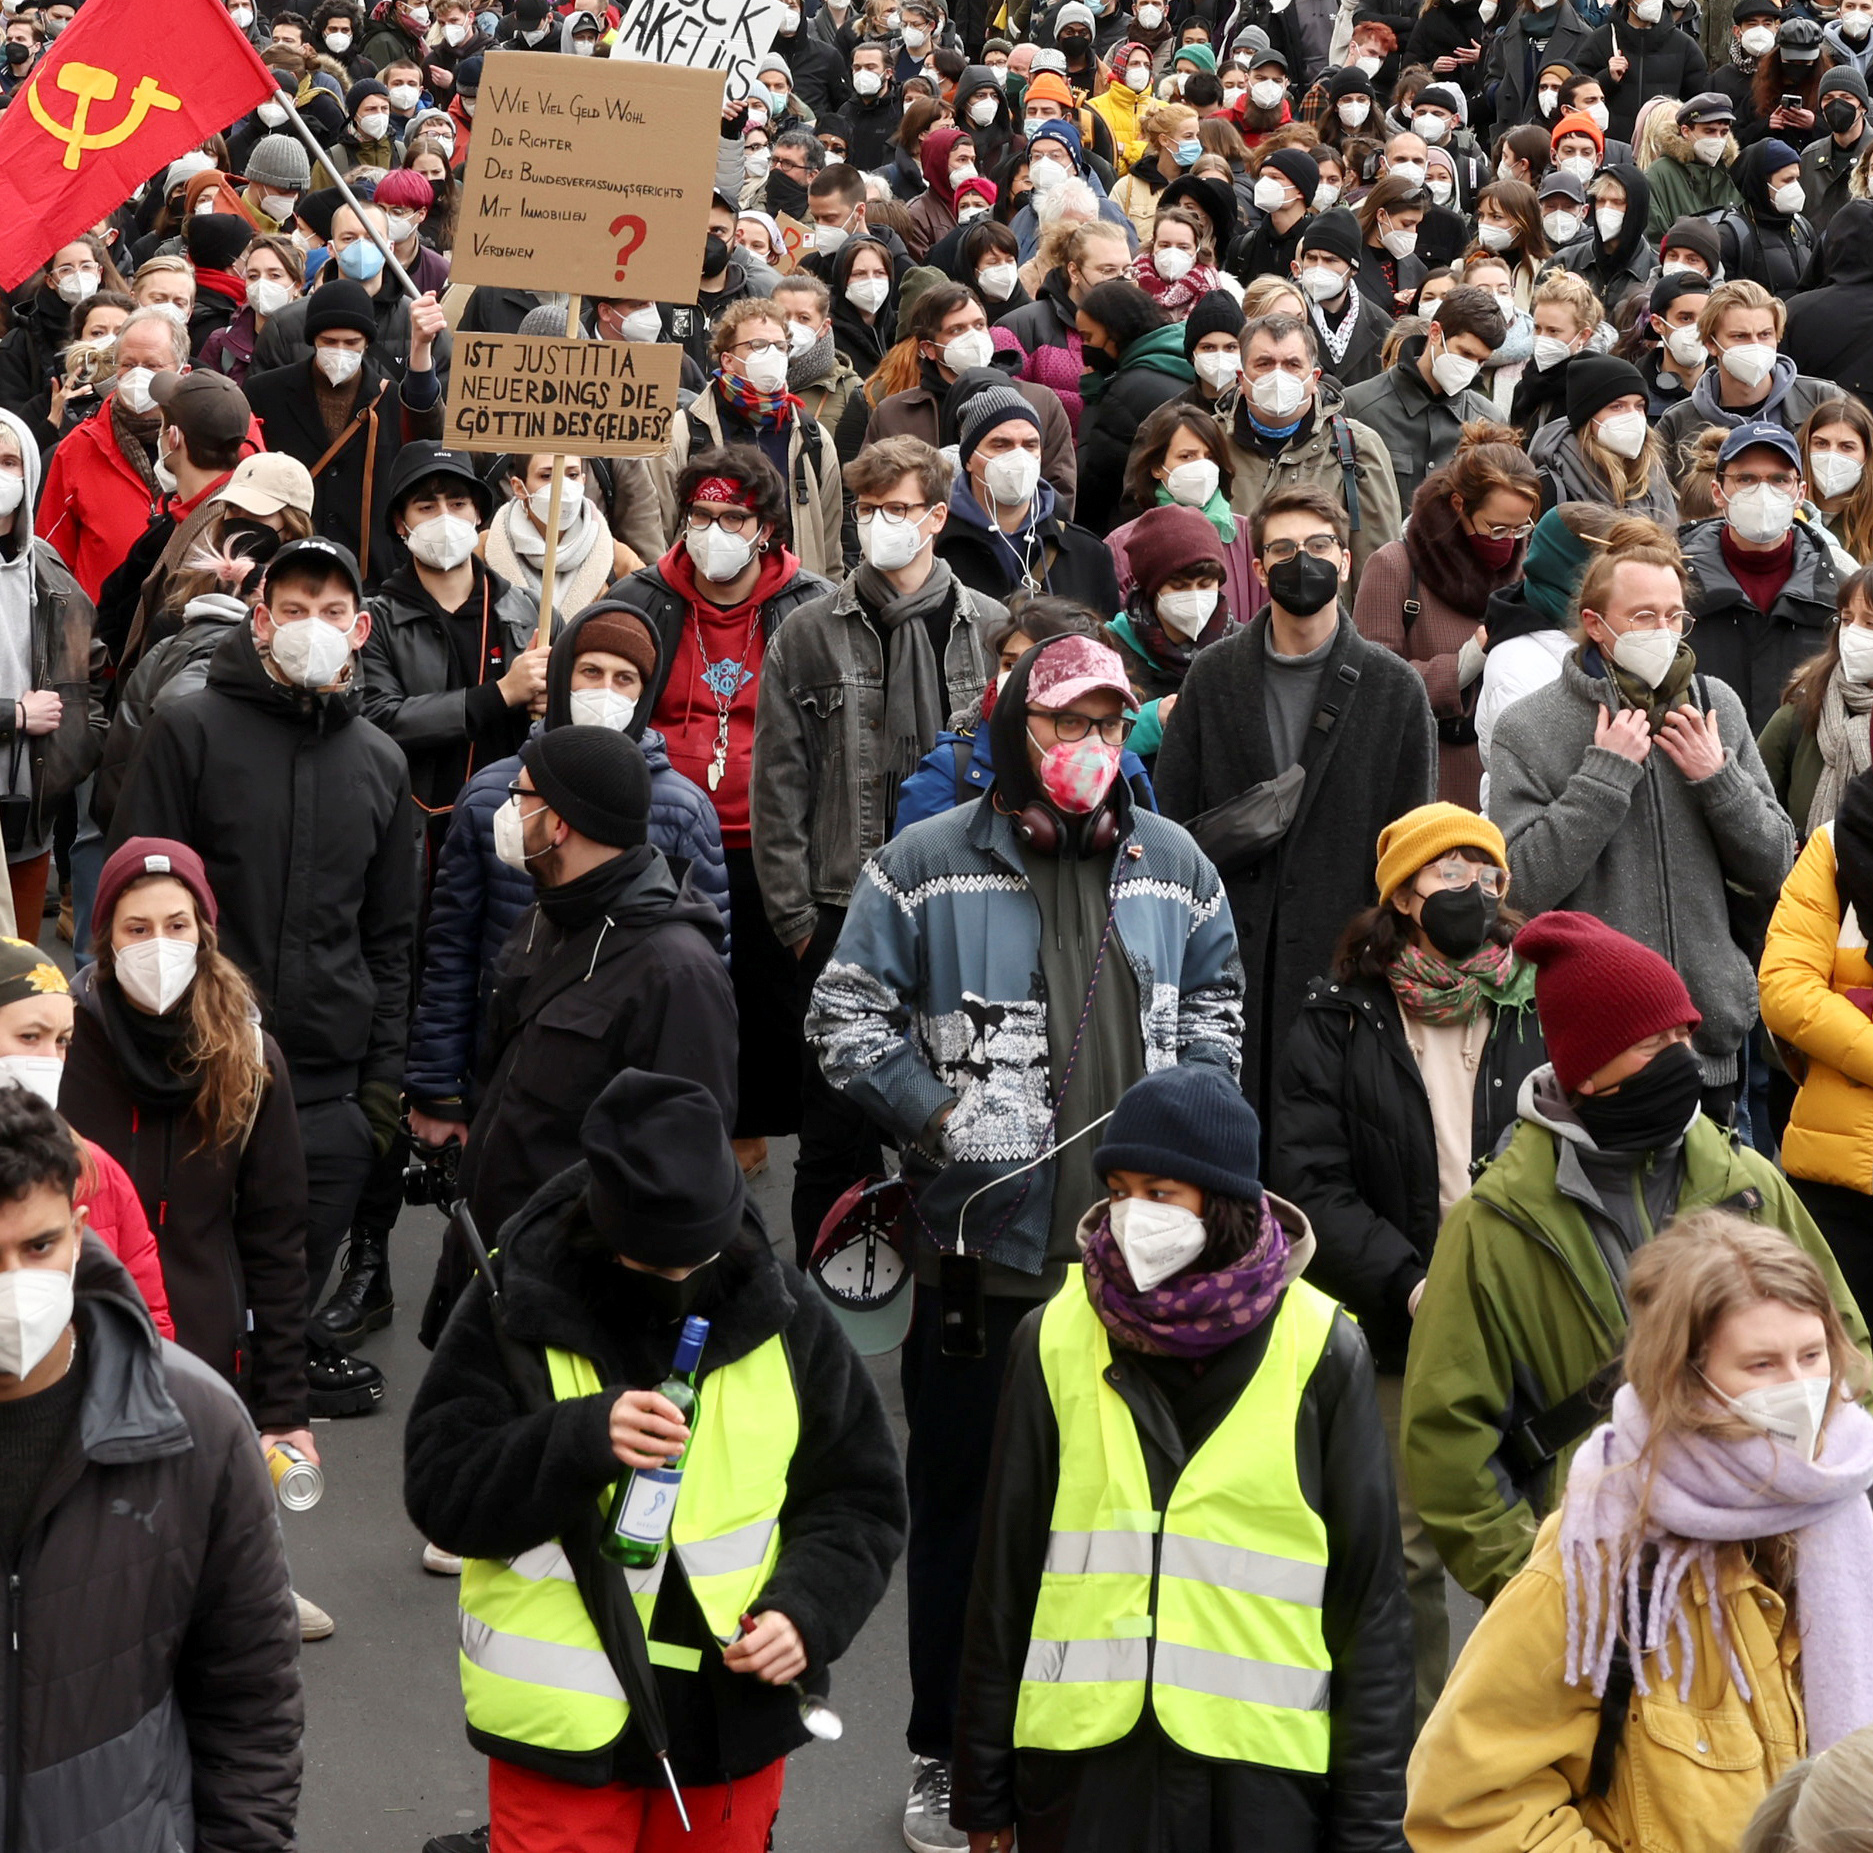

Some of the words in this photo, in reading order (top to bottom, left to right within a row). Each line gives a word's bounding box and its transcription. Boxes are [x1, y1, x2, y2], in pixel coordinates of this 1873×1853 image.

[607, 213, 648, 283] ?
[464, 342, 504, 368] IST
[513, 342, 636, 379] JUSTITIA
[460, 374, 610, 410] NEUERDINGS
[620, 382, 660, 410] DIE
[455, 405, 547, 440] GÖTTIN
[552, 408, 589, 438] DES
